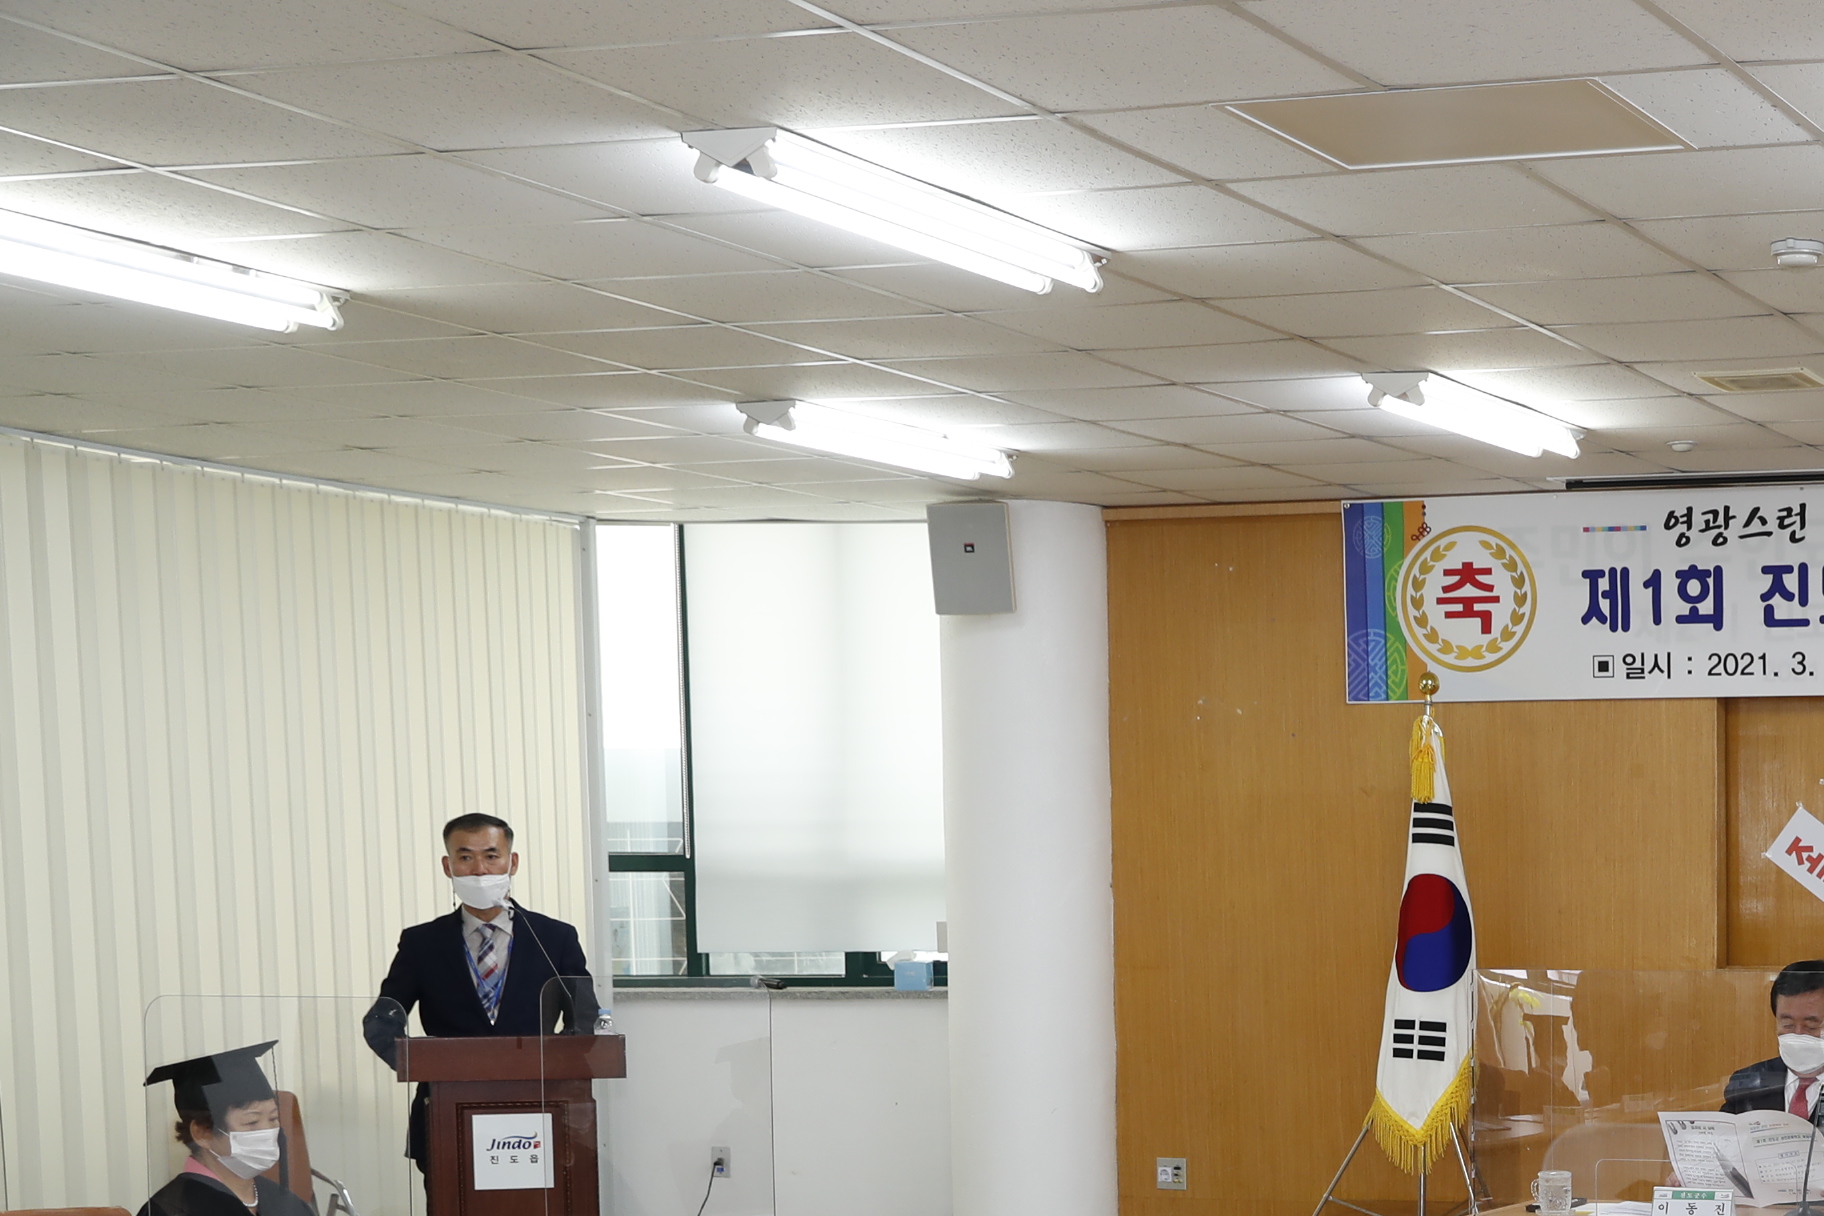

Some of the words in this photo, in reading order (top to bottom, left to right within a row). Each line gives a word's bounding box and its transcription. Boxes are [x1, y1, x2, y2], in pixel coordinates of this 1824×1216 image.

[1663, 502, 1807, 548] 영광스런
[1436, 561, 1501, 636] 축
[1581, 563, 1724, 634] 제1회
[1621, 651, 1672, 680] 일시
